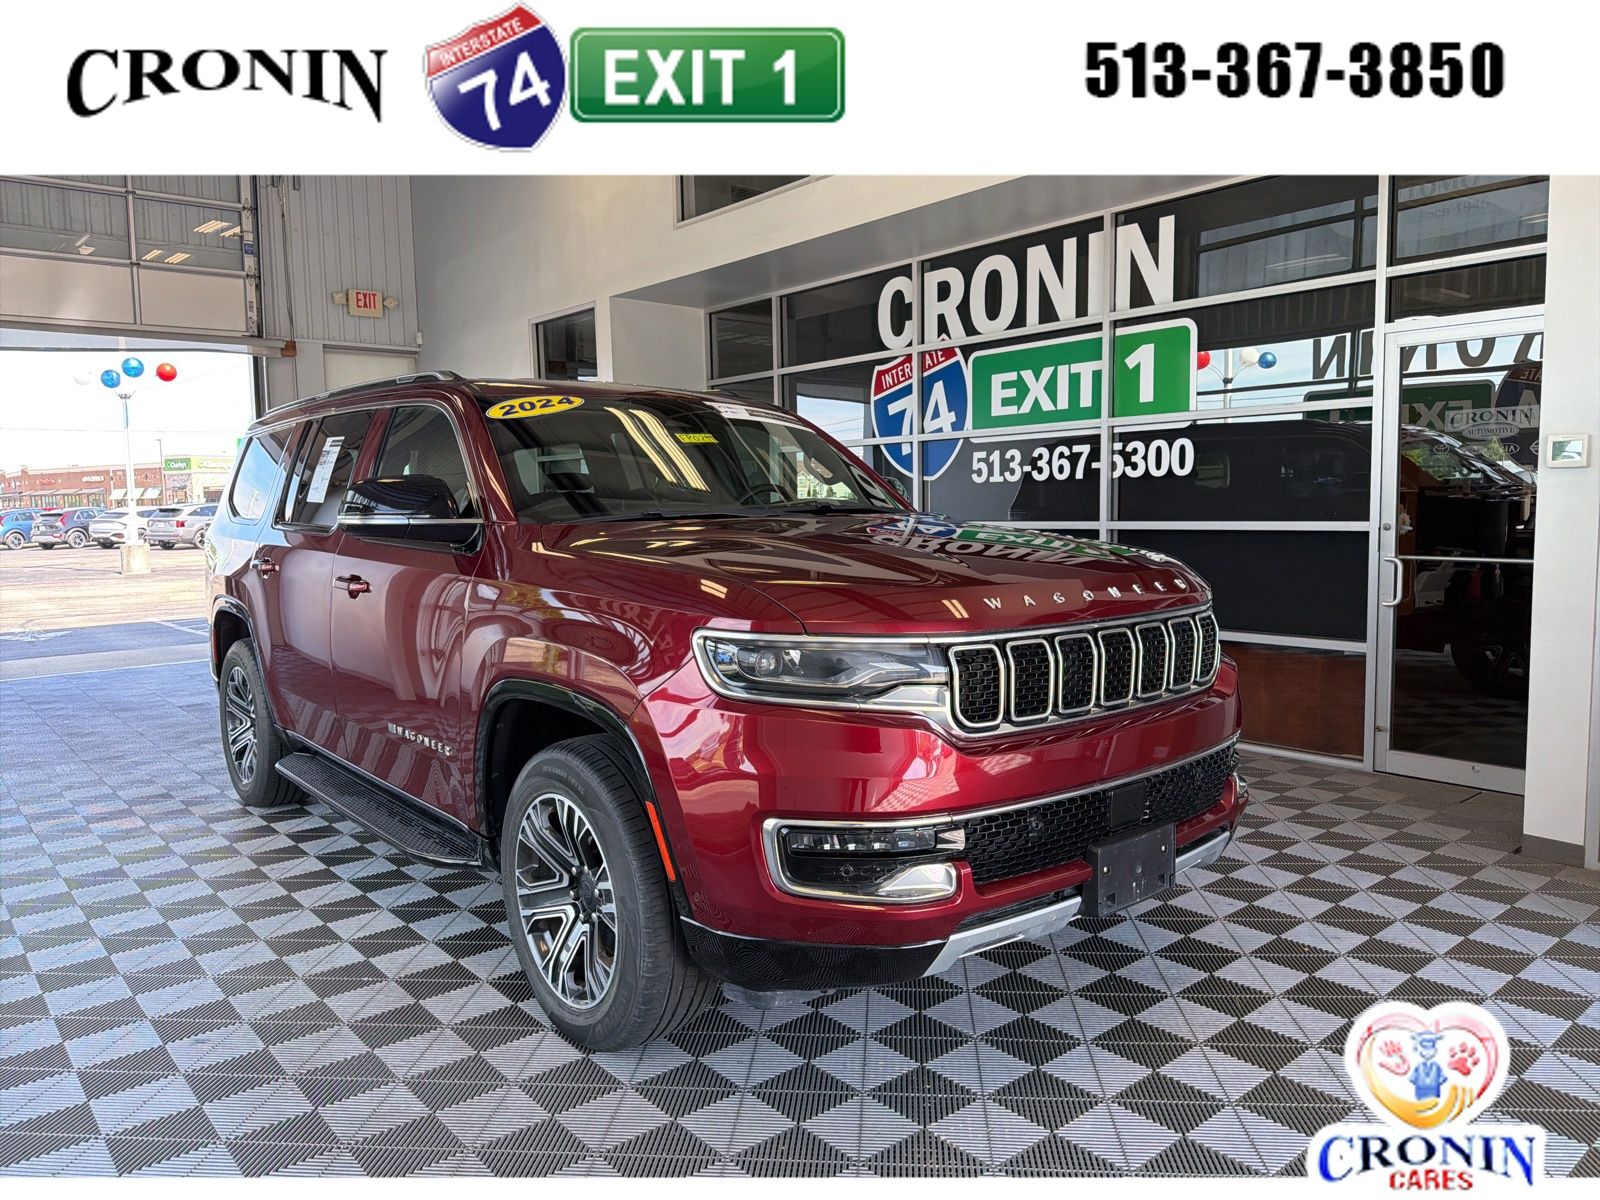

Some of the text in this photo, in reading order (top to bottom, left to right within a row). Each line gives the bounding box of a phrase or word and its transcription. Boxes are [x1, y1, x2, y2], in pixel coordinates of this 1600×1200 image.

[878, 215, 1176, 350] CRONIN
[355, 291, 377, 310] EXIT
[881, 351, 945, 390] INTERATE
[991, 343, 1155, 417] EXIT 1
[499, 396, 574, 416] 2024
[887, 380, 957, 456] 74
[1450, 408, 1533, 430] CRONIN
[1467, 427, 1515, 436] AUTOMOTIVE
[971, 437, 1195, 484] 513-367-5300
[983, 578, 1187, 610] WAGONEER
[396, 726, 452, 756] WAGONEER
